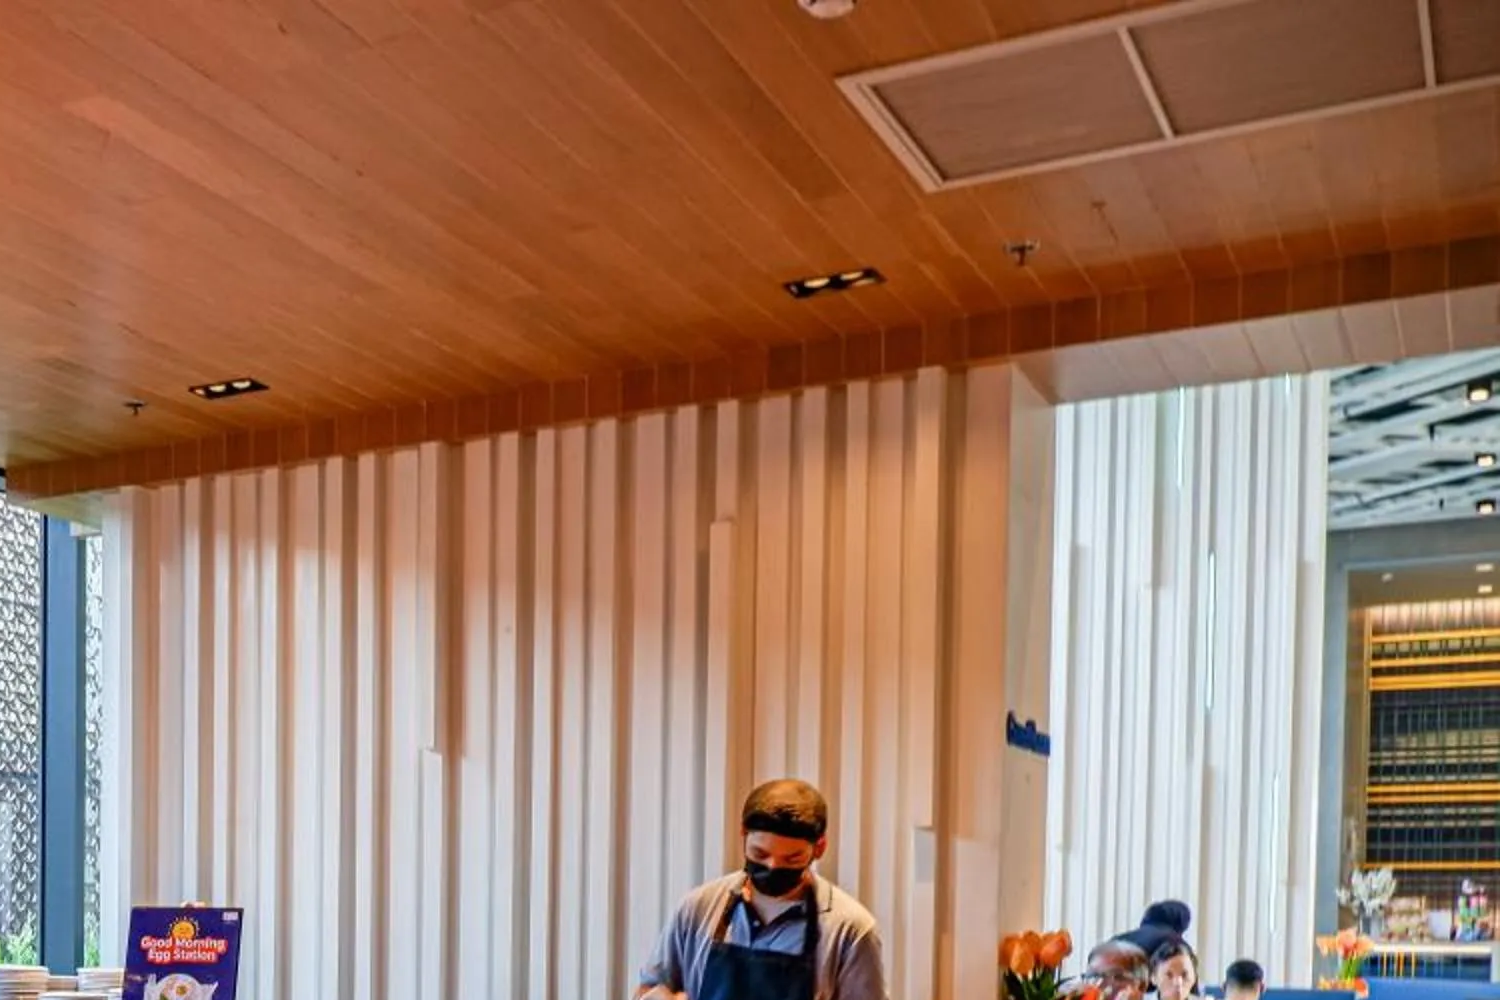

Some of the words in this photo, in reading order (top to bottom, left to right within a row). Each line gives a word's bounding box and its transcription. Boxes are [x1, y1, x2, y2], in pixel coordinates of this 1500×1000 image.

[141, 935, 173, 949] Good
[175, 936, 227, 954] Morning
[148, 949, 171, 963] Egg
[173, 949, 217, 962] Station
